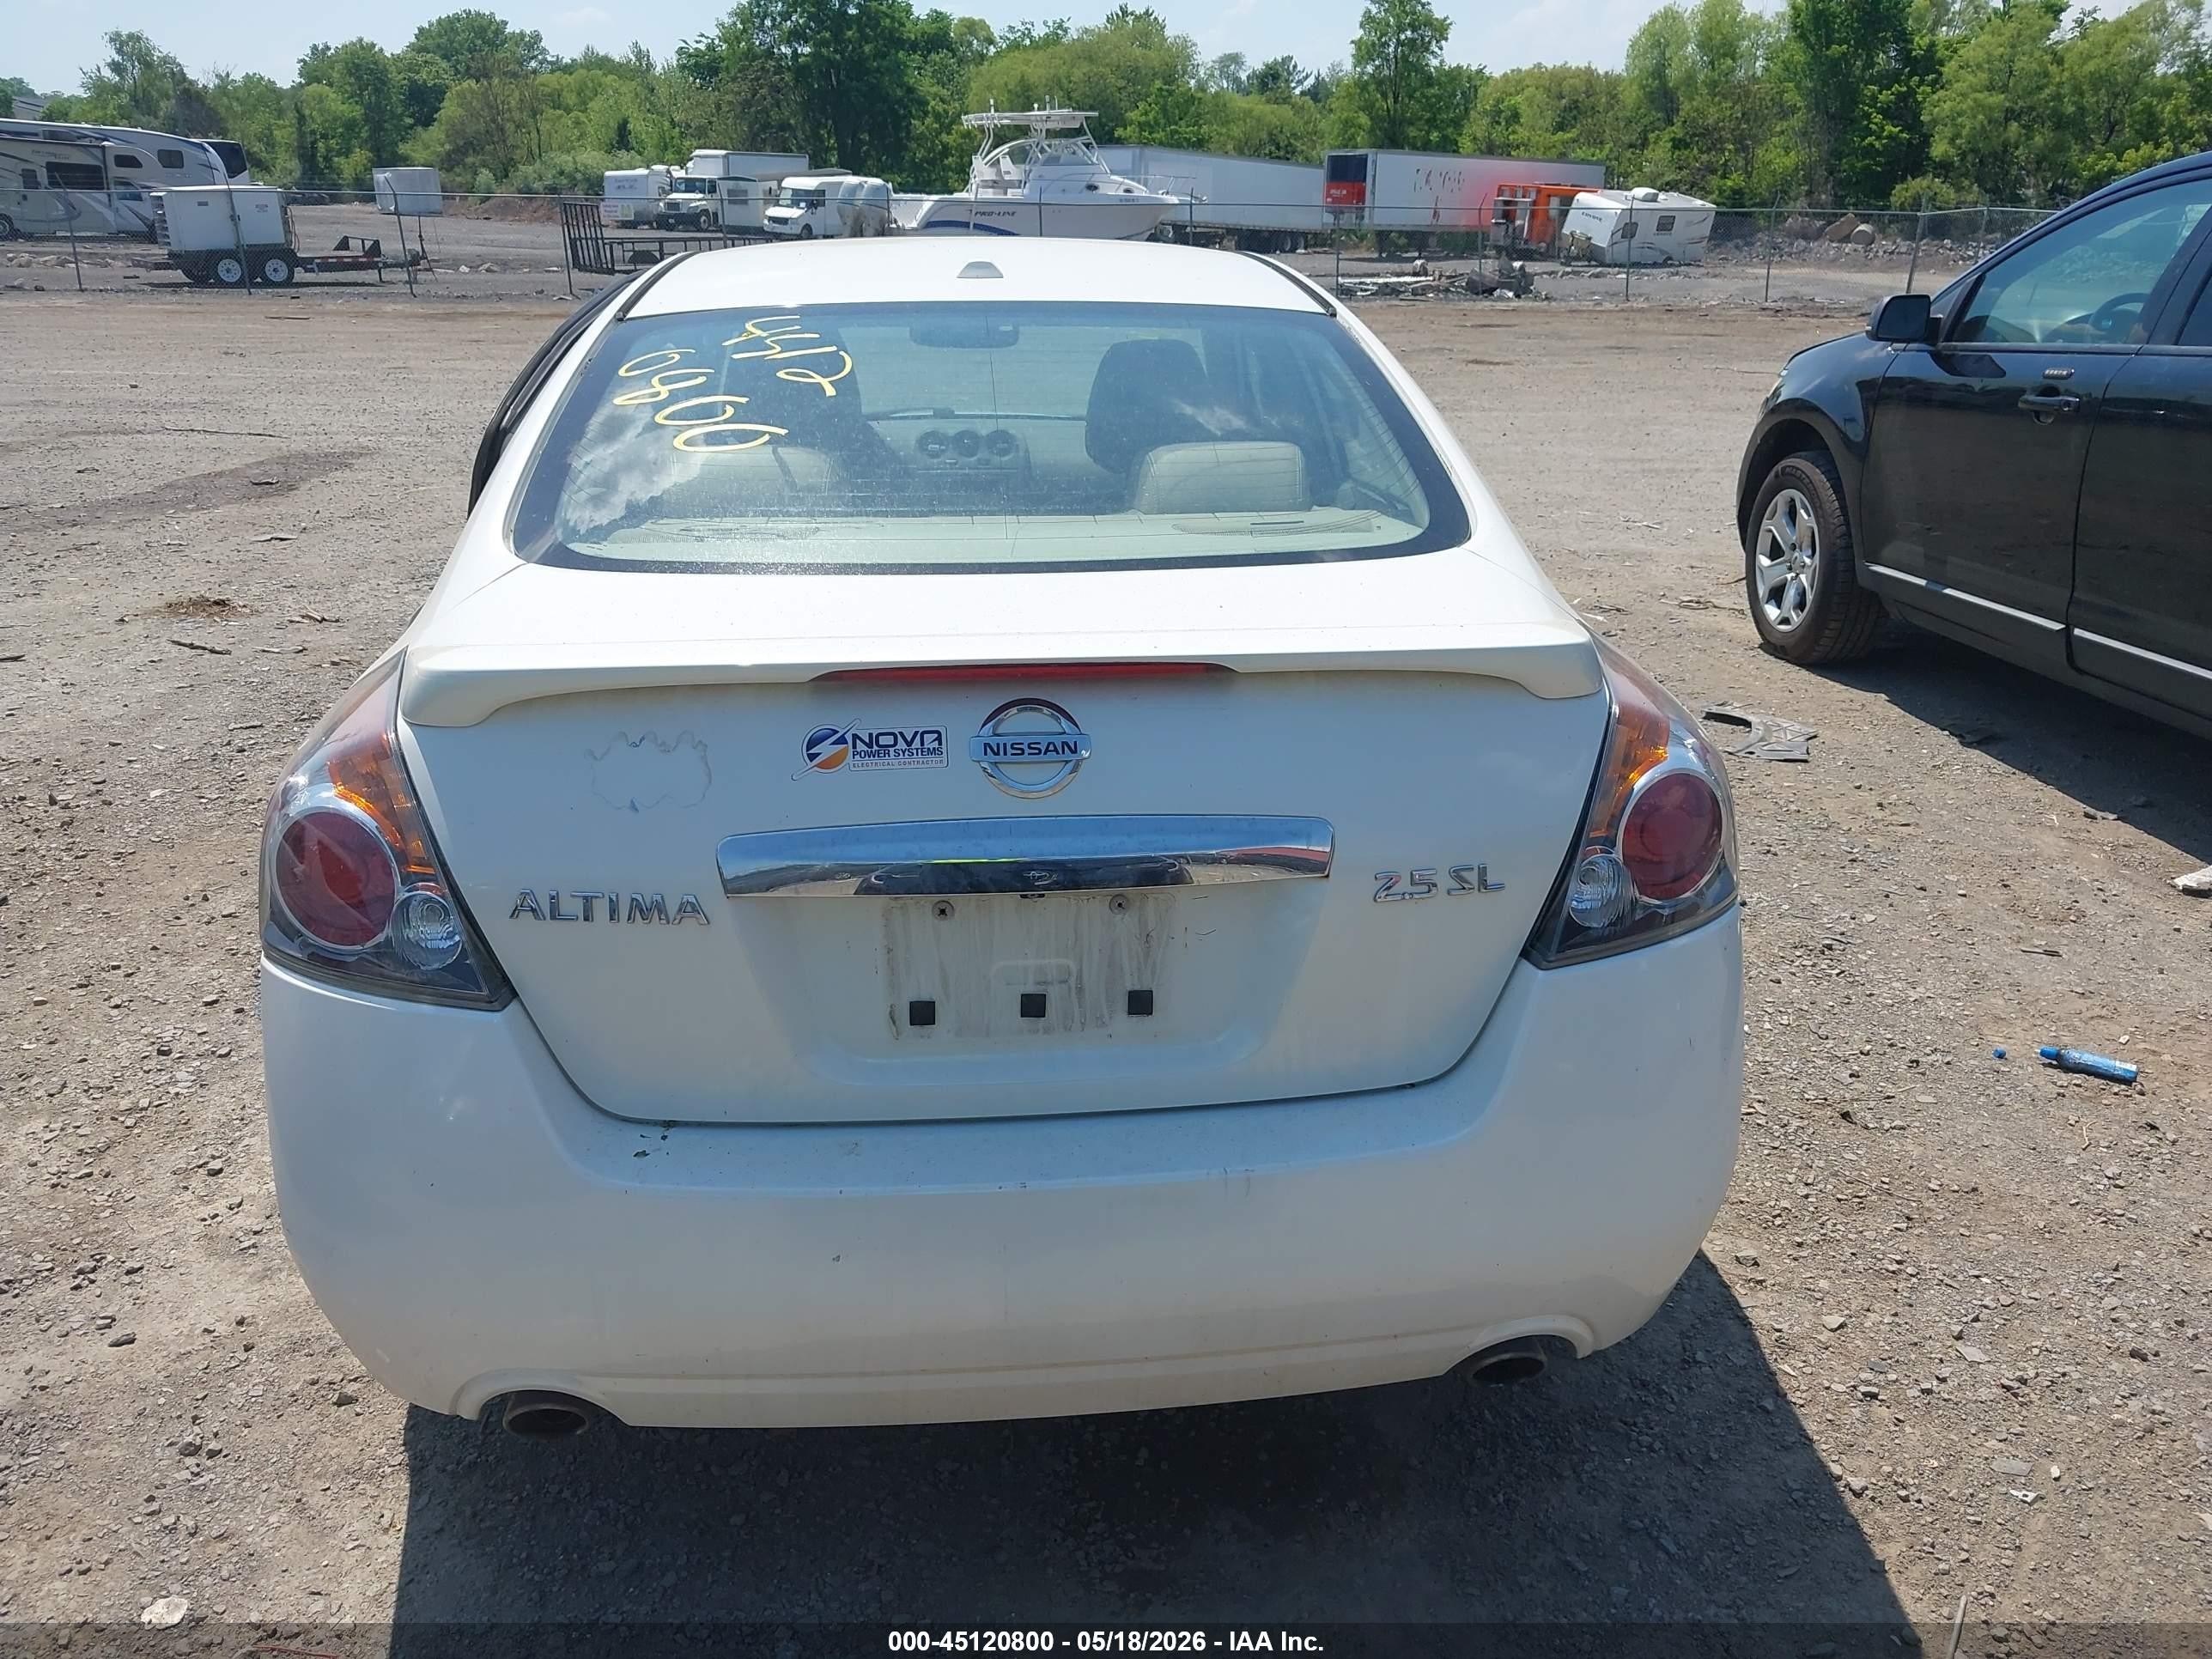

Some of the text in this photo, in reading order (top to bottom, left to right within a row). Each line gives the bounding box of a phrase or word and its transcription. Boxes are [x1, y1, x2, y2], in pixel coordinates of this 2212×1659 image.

[612, 349, 789, 453] 0800
[851, 730, 943, 750] NOVA
[852, 746, 944, 759] POWER SYSTEMS
[982, 740, 1079, 757] NISSAN
[1374, 863, 1505, 902] 2.5 SL
[508, 888, 711, 926] ALTIMA
